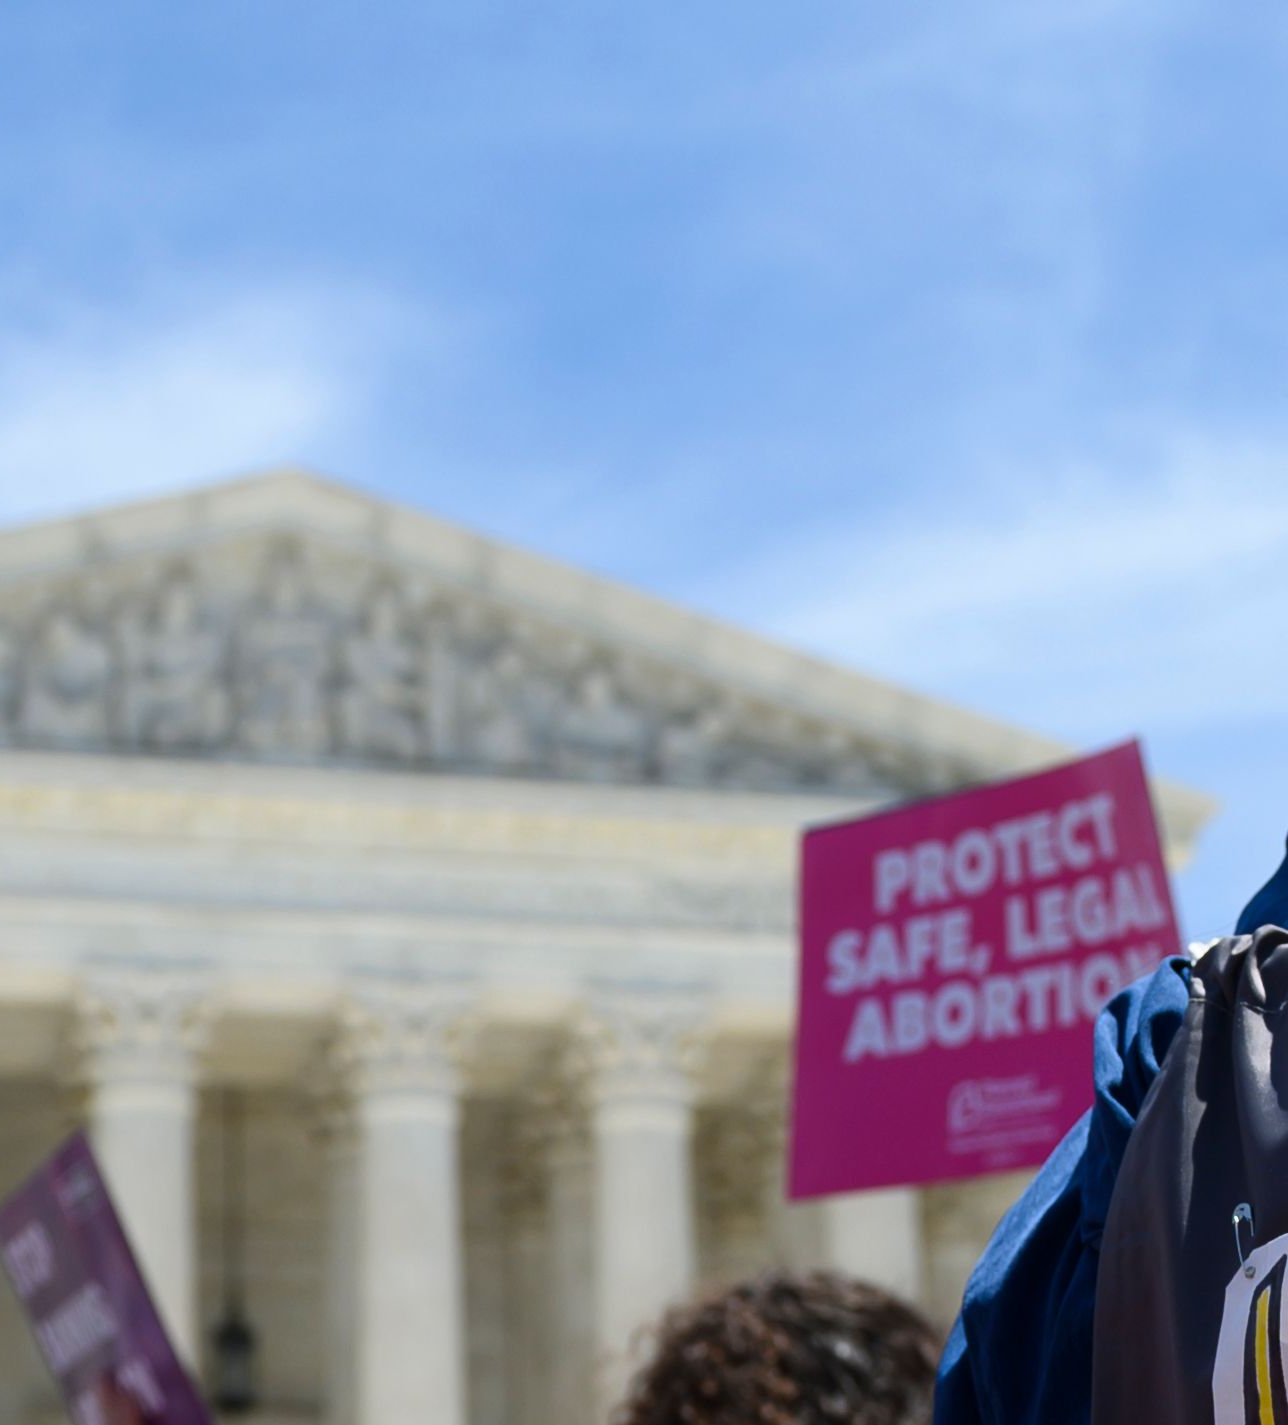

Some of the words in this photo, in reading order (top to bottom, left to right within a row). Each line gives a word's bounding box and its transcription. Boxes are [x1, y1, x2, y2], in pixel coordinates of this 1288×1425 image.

[875, 798, 1115, 911] PROTECT
[827, 909, 991, 993] SAFE,
[1007, 867, 1165, 958] LEGAL
